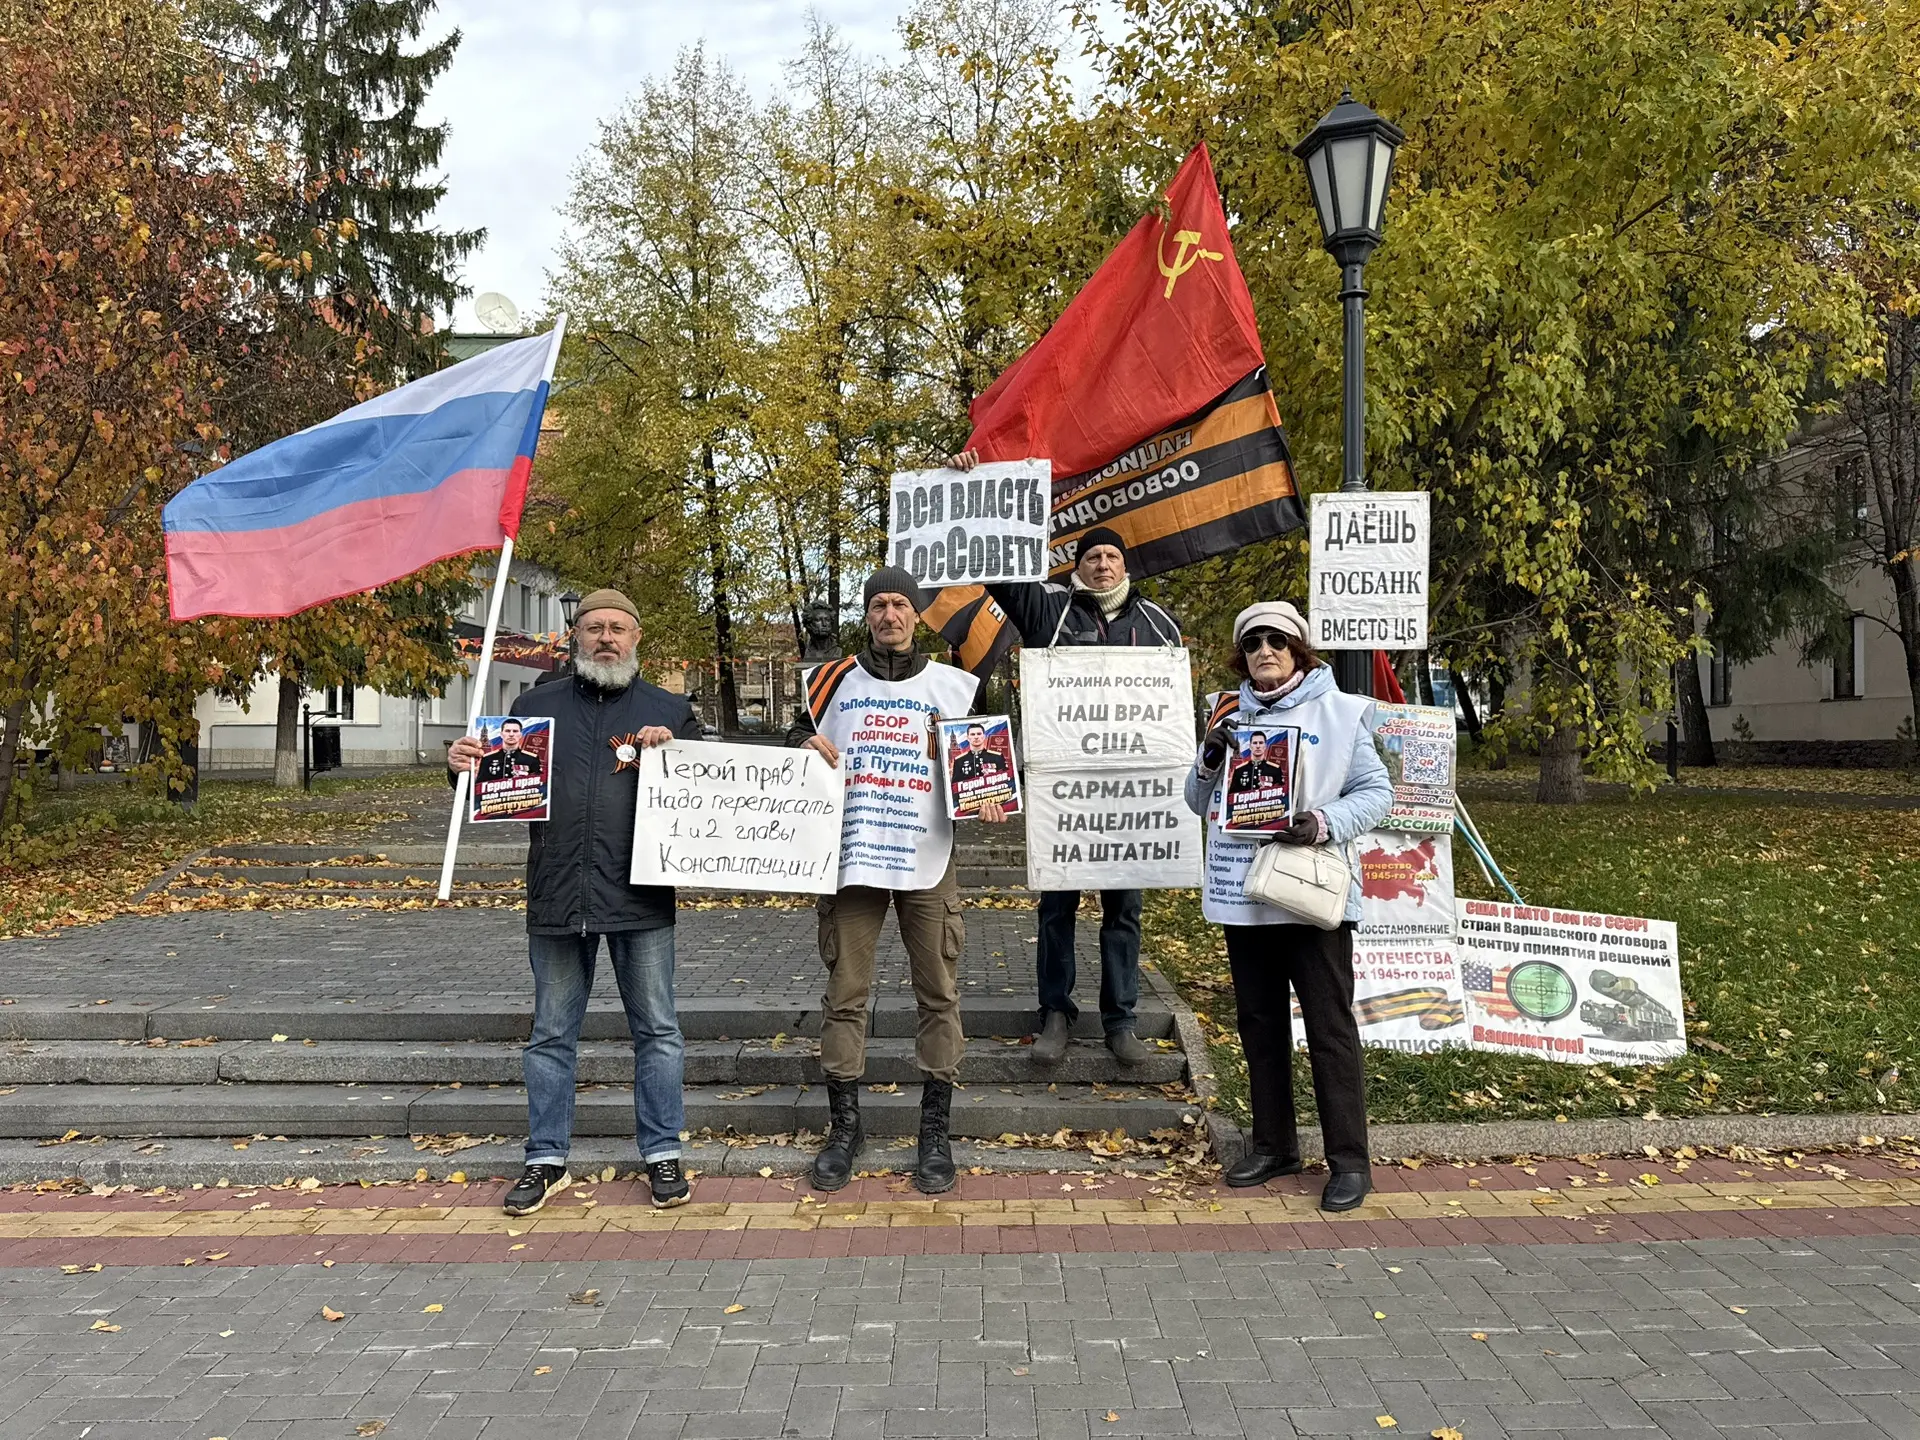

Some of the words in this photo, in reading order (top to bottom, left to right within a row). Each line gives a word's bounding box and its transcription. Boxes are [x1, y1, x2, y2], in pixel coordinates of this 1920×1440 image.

[896, 484, 943, 534] ВСЯ
[950, 478, 1044, 526] ВЛАСТЬ
[1325, 503, 1416, 551] ДАЁШЬ
[1320, 571, 1422, 595] ГОСБАНК
[1322, 618, 1388, 641] ВМЕСТО
[1395, 618, 1417, 645] ЦБ
[1048, 676, 1111, 688] УКРАИНА
[1115, 676, 1174, 690] РОССИЯ,
[864, 714, 909, 729] СБОР
[1057, 704, 1108, 722] НАШ
[1115, 704, 1169, 722] ВРАГ
[852, 730, 919, 745] ПОДПИСЕЙ
[1377, 726, 1454, 739] GORBSUD.RU
[1081, 732, 1148, 754] США
[847, 747, 854, 755] в
[857, 744, 921, 761] поддержку
[661, 749, 735, 786] Герой
[871, 755, 929, 776] Путина
[1419, 758, 1434, 766] QR
[481, 779, 513, 793] Герой
[854, 773, 895, 788] Победы
[908, 777, 932, 793] СВО
[1052, 778, 1173, 800] САРМАТЫ
[648, 786, 703, 810] Надо
[711, 794, 835, 816] переписать
[871, 790, 914, 803] Победы:
[1233, 790, 1260, 804] Герой
[1396, 794, 1452, 805] RusNOD.RU
[843, 804, 884, 816] уверенитет
[886, 806, 919, 818] России
[1418, 810, 1442, 819] 1945
[669, 818, 682, 838] 1
[689, 828, 700, 839] и
[705, 818, 722, 838] 2
[735, 820, 796, 842] главы
[1057, 811, 1179, 834] НАЦЕЛИТЬ
[1380, 818, 1451, 832] РОССИИ!
[1052, 843, 1082, 863] НА
[1088, 840, 1180, 862] ШТАТЫ!
[1361, 862, 1412, 870] течество
[1366, 871, 1406, 881] 1945-го
[1466, 901, 1498, 917] США
[1514, 905, 1550, 922] НАТО
[1604, 915, 1649, 933] СССР!
[1461, 919, 1501, 932] стран
[1504, 921, 1597, 943] Варшавского
[1600, 933, 1667, 950] договора
[1367, 951, 1453, 965] ОТЕЧЕСТВА
[1468, 937, 1520, 953] центру
[1523, 943, 1596, 961] принятия
[1599, 951, 1672, 968] решений
[1371, 967, 1418, 980] 1945-го
[1423, 968, 1456, 982] года!
[1473, 1025, 1584, 1054] Вашингтон!
